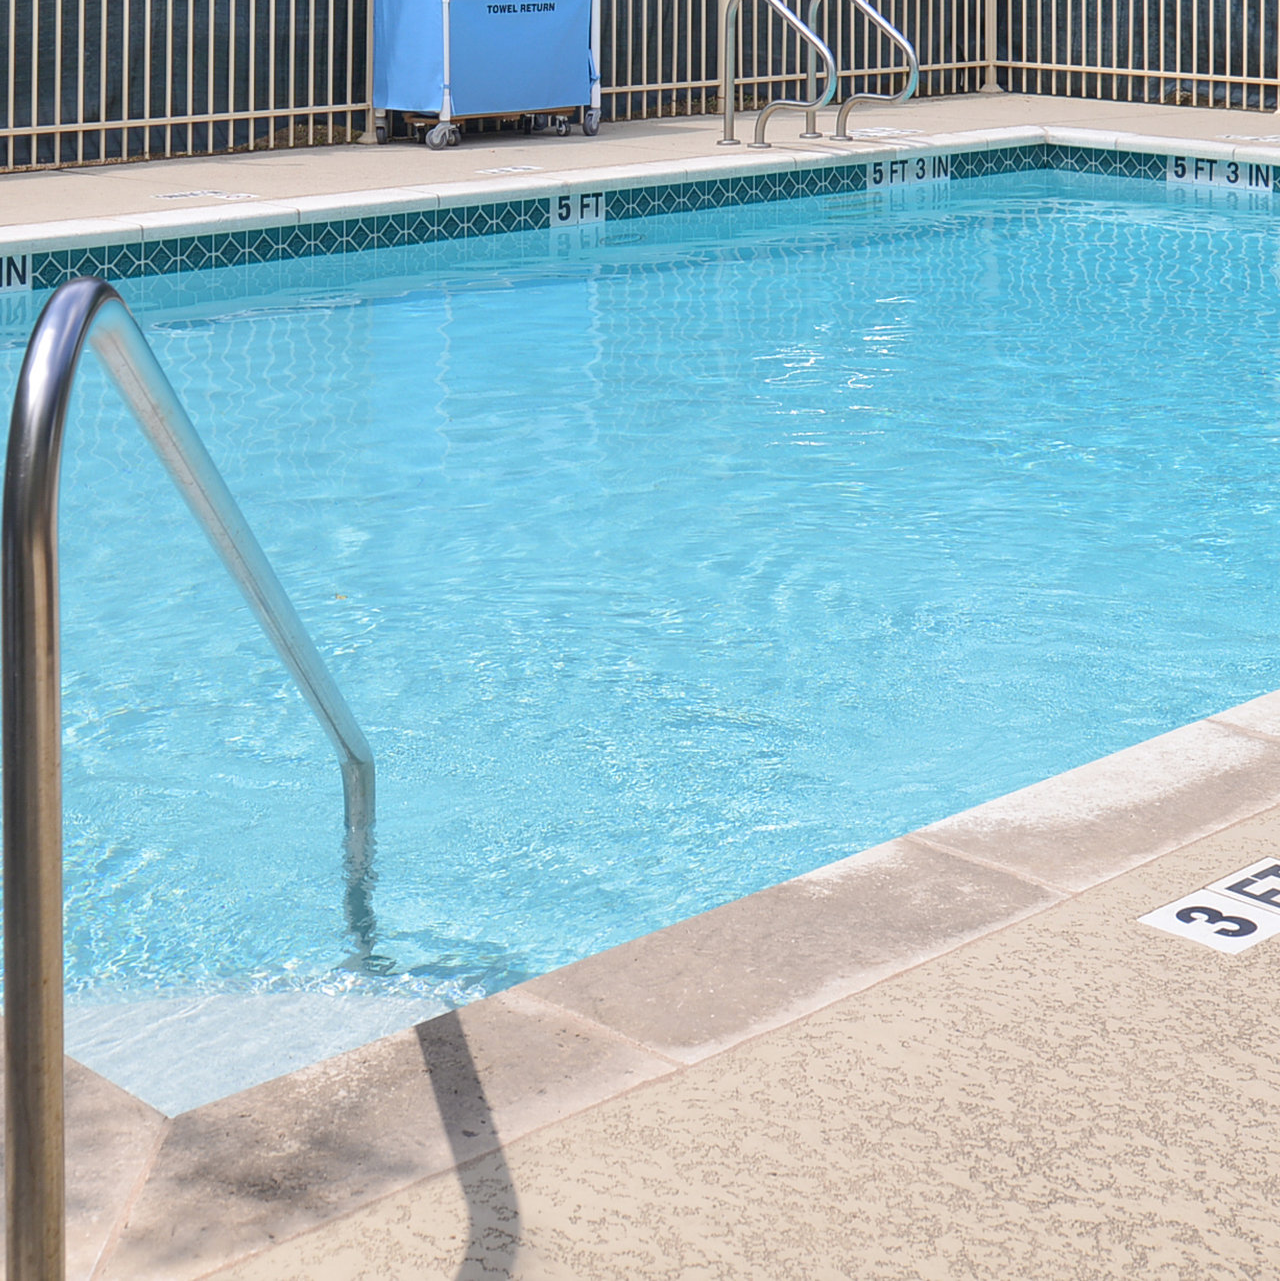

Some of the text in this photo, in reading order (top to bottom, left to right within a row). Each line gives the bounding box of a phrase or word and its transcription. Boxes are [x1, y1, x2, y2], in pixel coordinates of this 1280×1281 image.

[487, 2, 556, 14] TOWEL RETURN
[873, 155, 949, 185] 5 FT 3 IN
[1174, 156, 1270, 188] 5 FT 3 IN
[558, 192, 603, 221] 5 FT
[1175, 905, 1259, 938] 3
